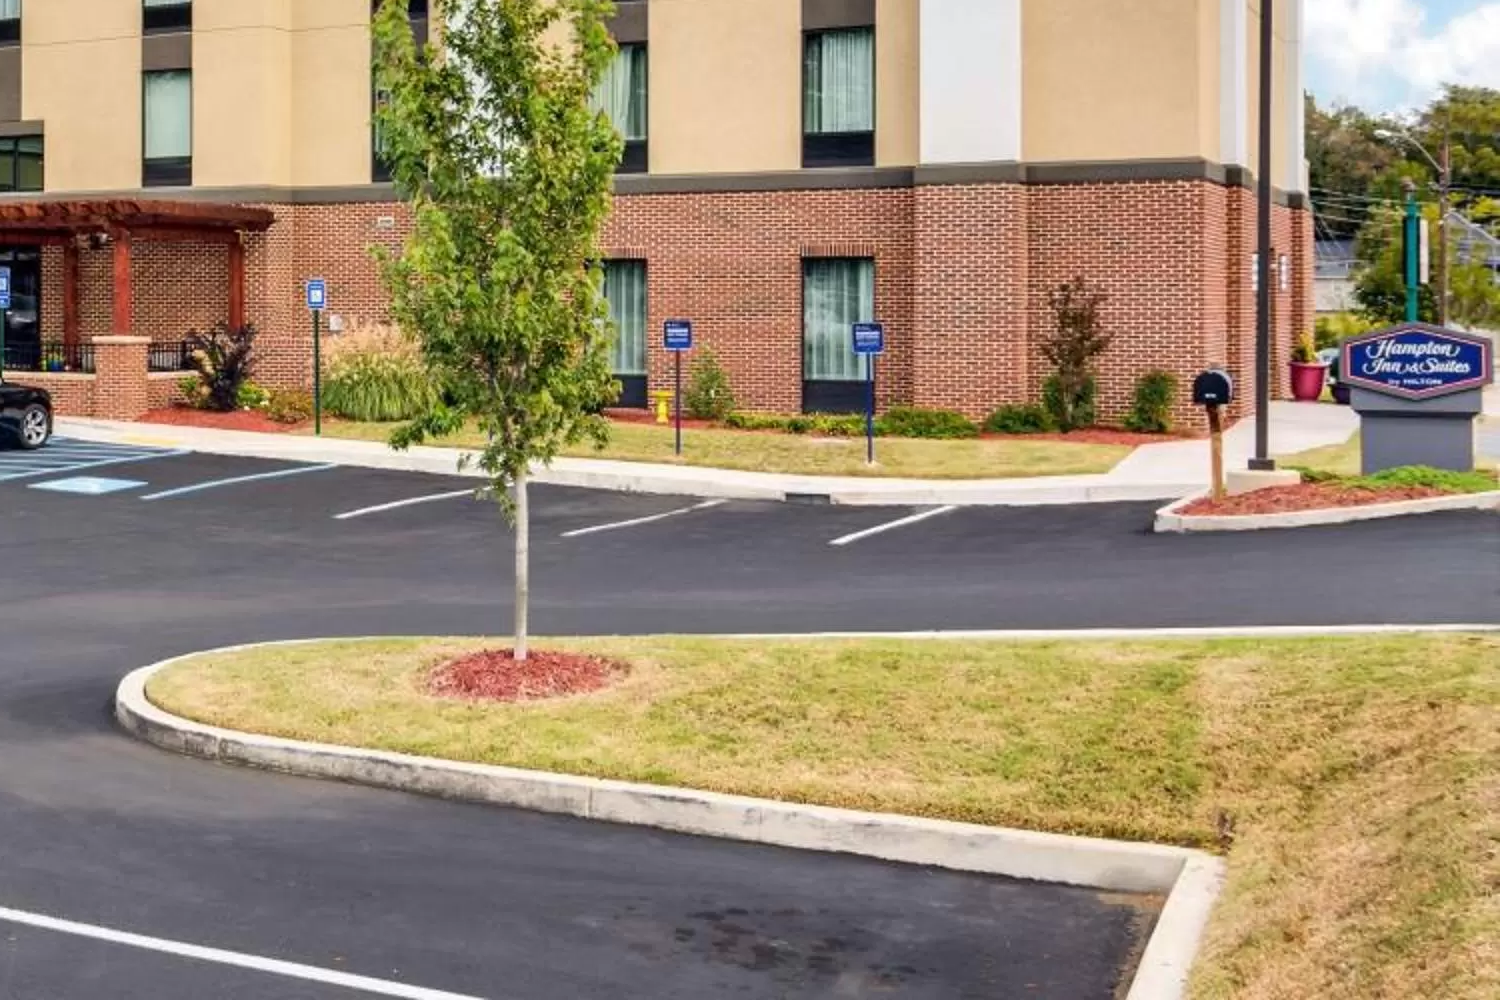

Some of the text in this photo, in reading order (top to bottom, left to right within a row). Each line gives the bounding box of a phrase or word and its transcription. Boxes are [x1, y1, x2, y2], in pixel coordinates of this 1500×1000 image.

[1366, 339, 1460, 359] Hampton
[1362, 357, 1406, 374] Inn
[1419, 357, 1471, 374] Suites
